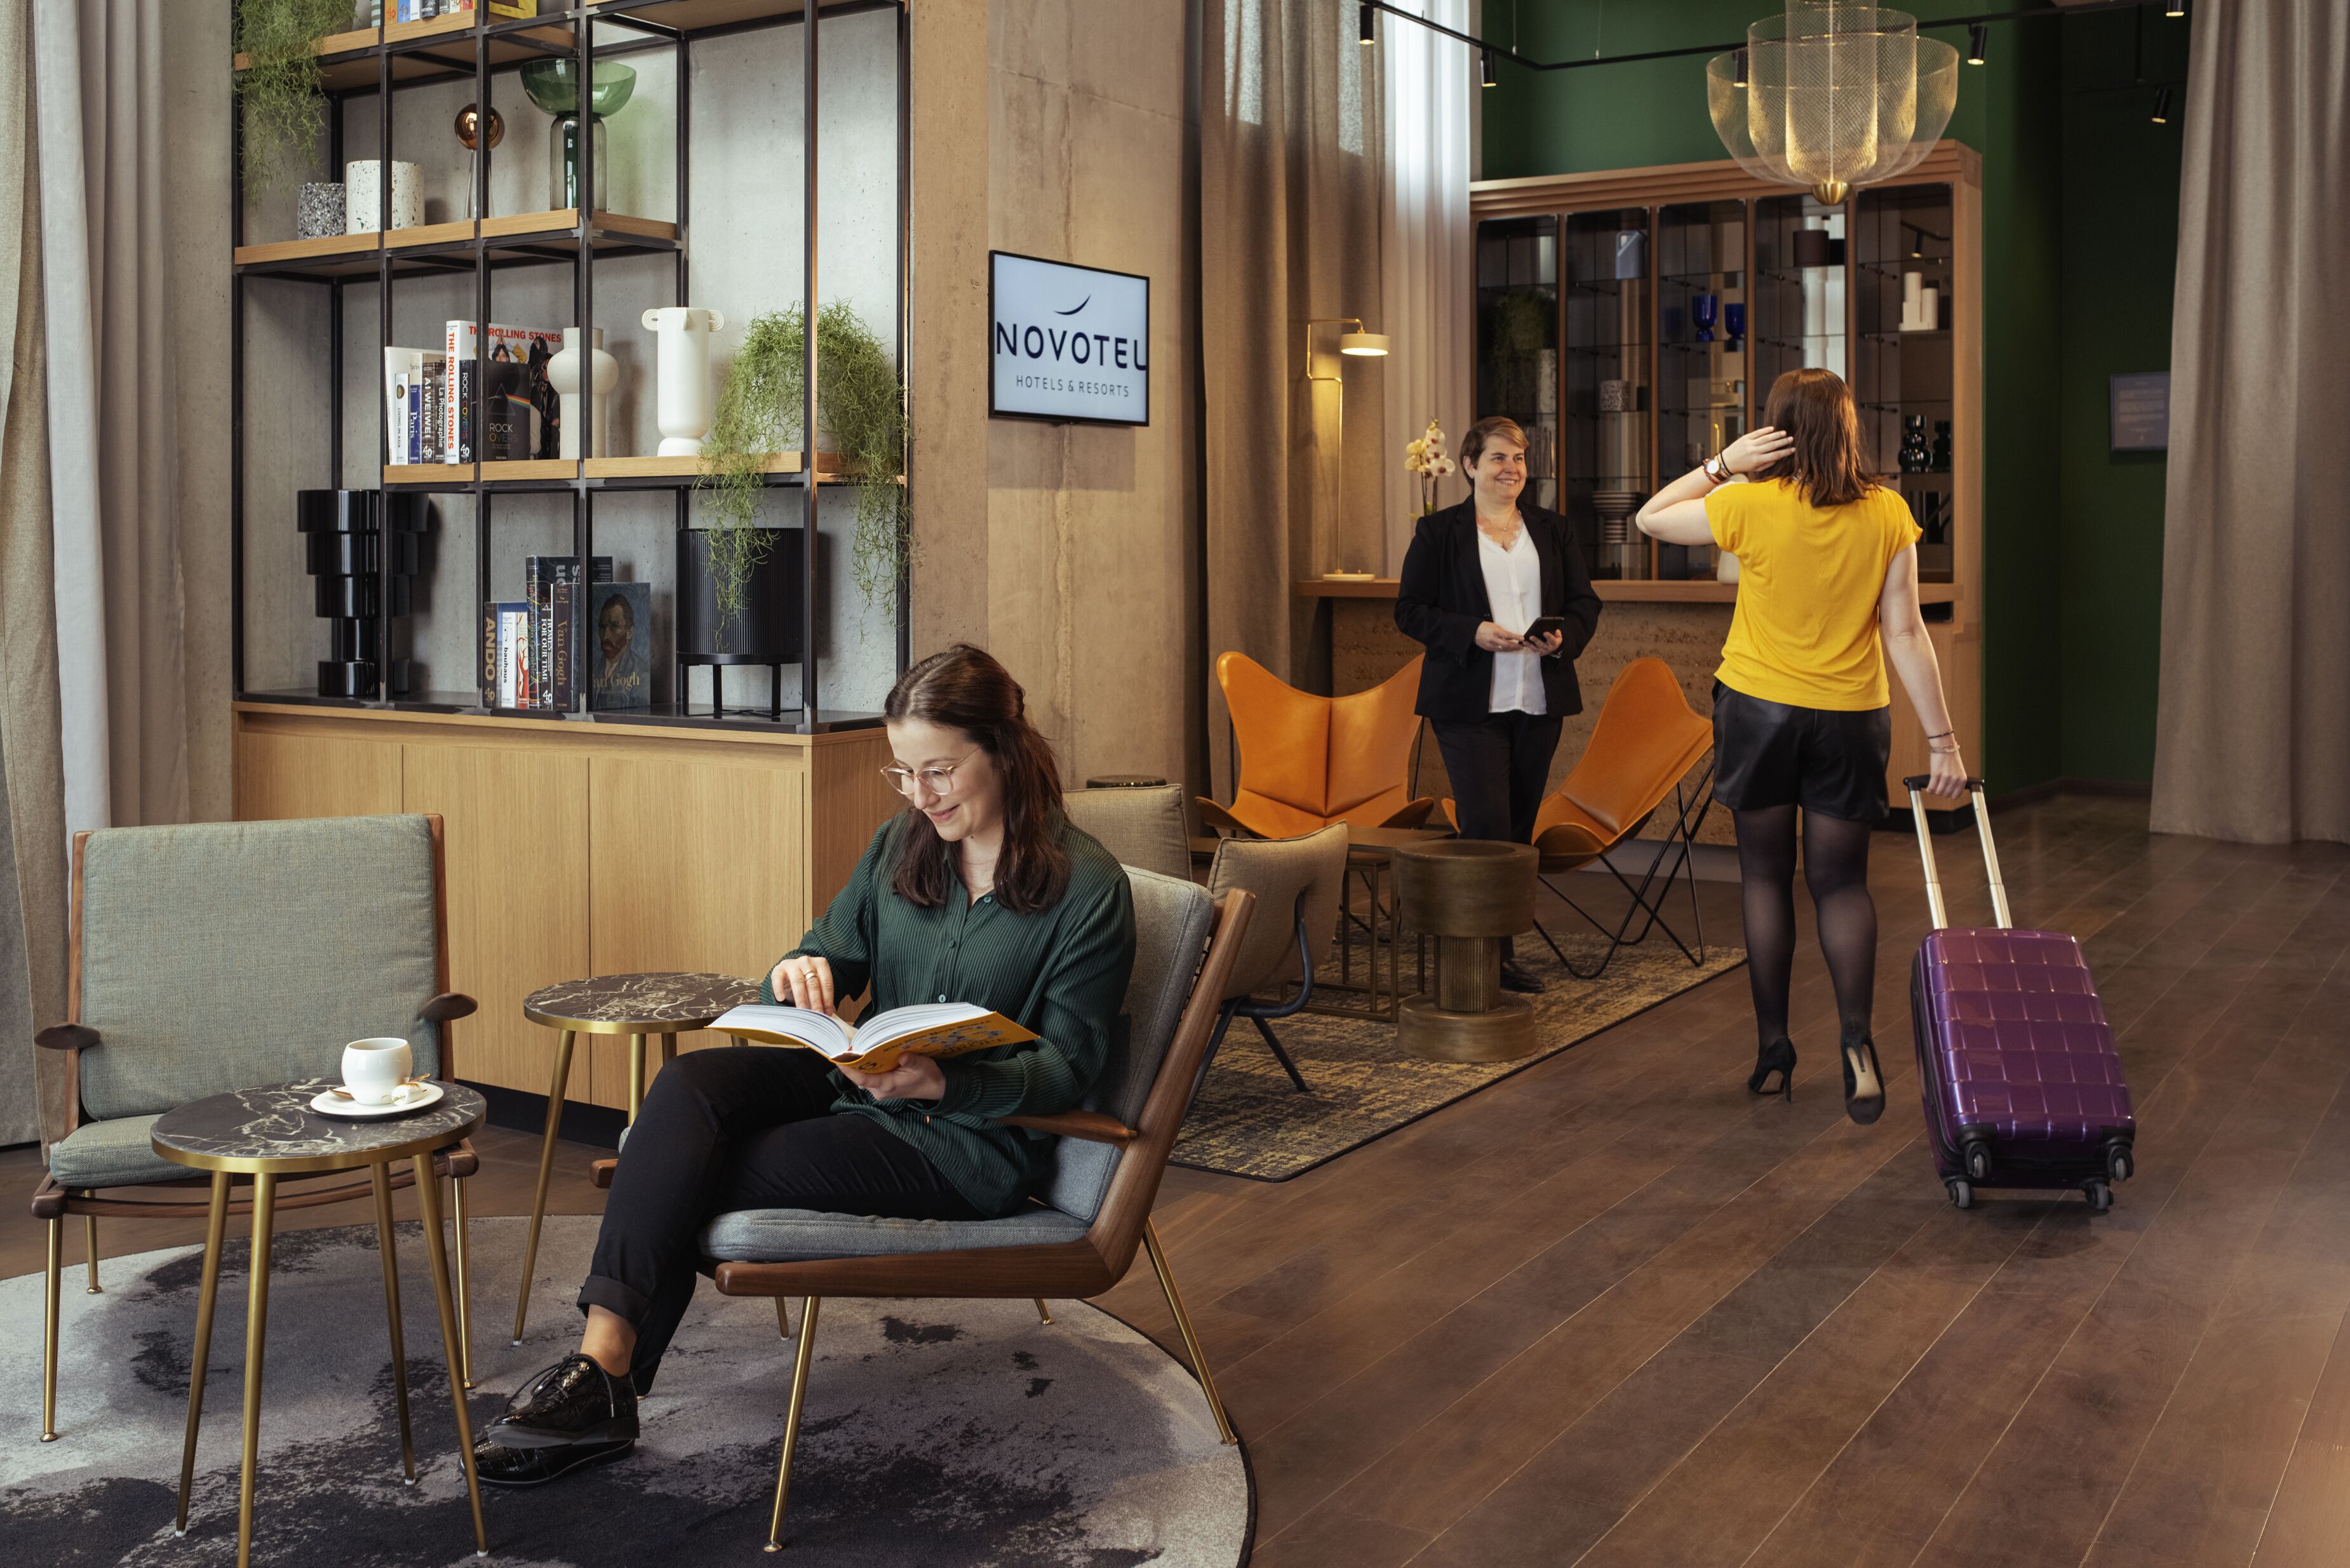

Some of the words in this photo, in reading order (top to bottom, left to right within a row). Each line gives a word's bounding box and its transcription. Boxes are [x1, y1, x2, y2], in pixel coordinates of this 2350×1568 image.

[528, 332, 561, 343] STONES
[997, 321, 1146, 371] NOVOTEL
[424, 377, 431, 389] AI
[1016, 375, 1063, 391] HOTELS
[1068, 380, 1075, 392] &
[1079, 381, 1129, 397] RESORTS
[438, 387, 445, 396] La
[489, 423, 513, 432] ROCK
[489, 432, 519, 443] OVERS
[460, 443, 470, 456] 40
[558, 619, 567, 647] Van
[485, 616, 495, 681] ANDO
[555, 650, 567, 686] Gogh
[593, 674, 607, 688] an
[610, 671, 640, 690] Gogh
